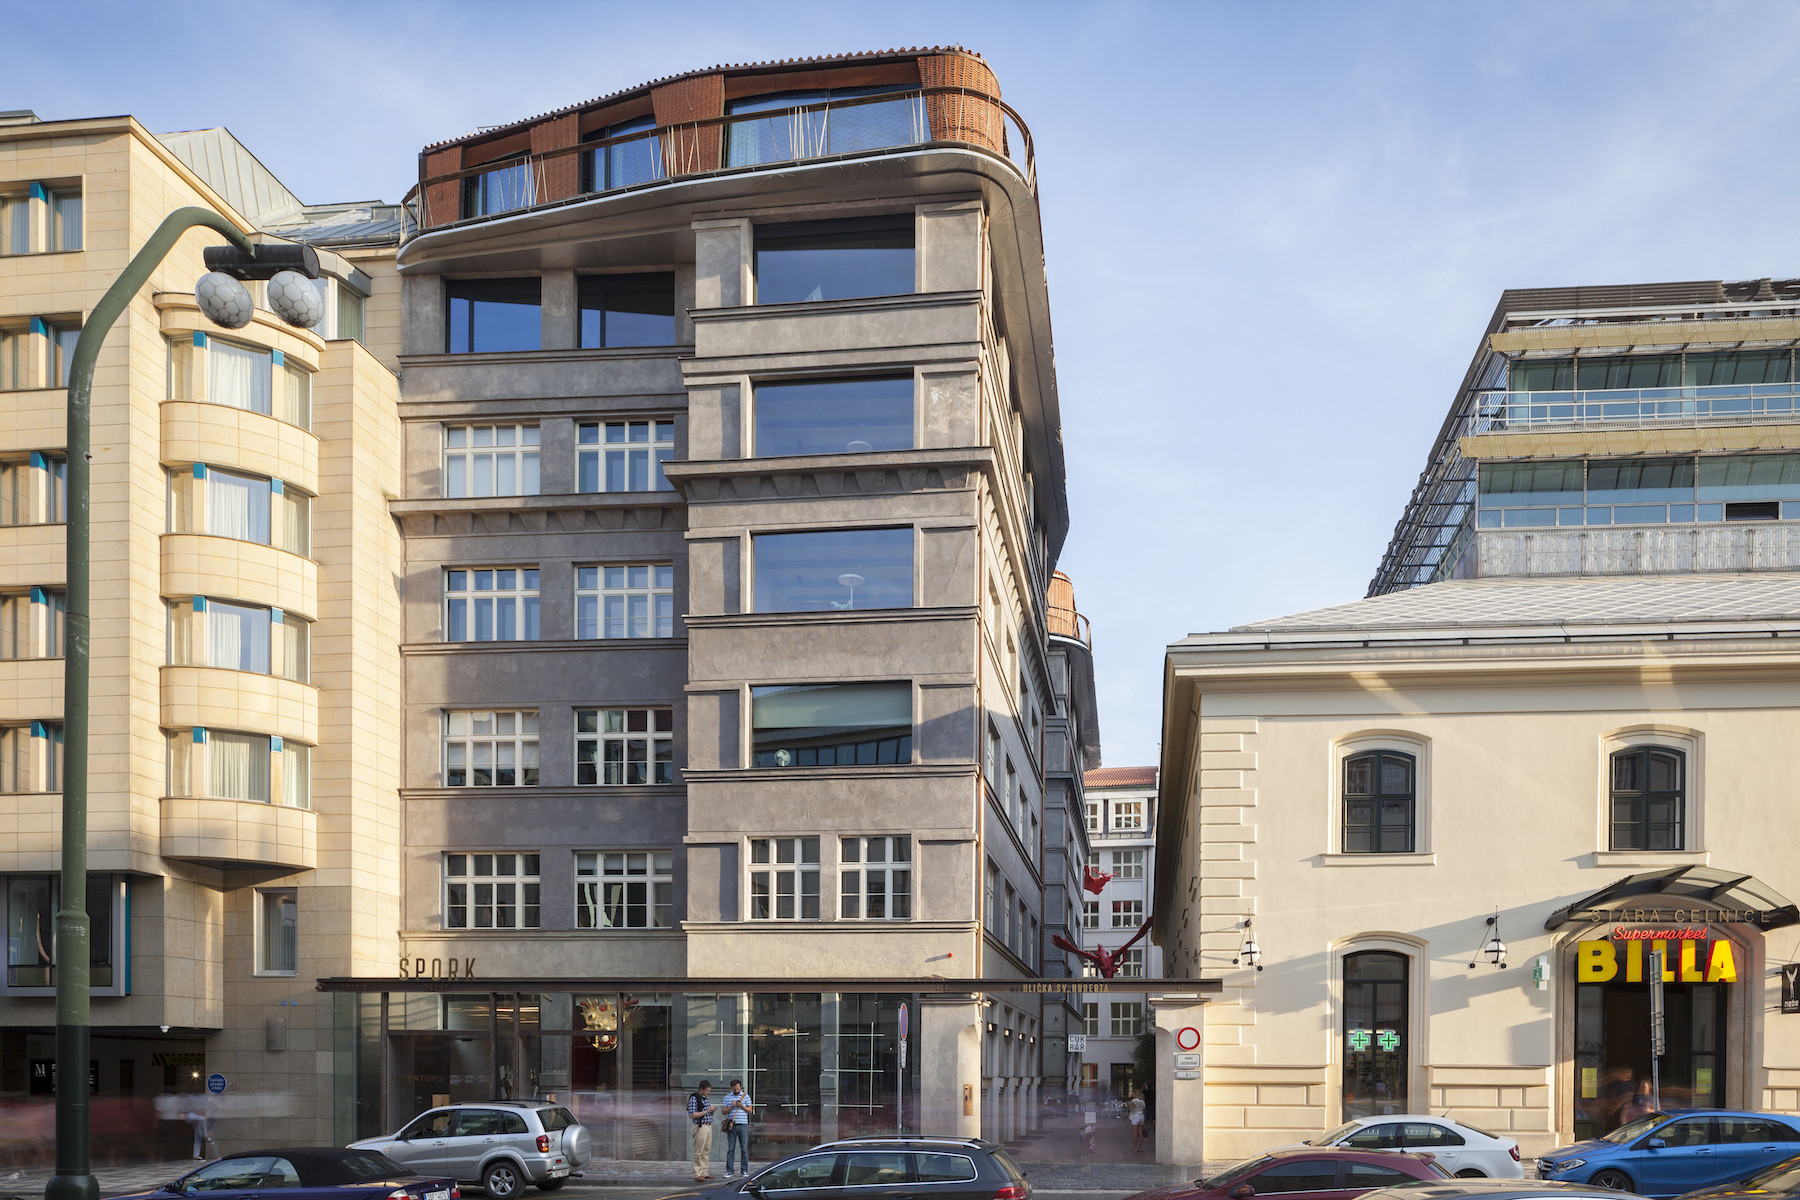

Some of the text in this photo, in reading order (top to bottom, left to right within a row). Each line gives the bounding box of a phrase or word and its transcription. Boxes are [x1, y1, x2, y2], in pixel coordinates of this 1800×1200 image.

[1674, 909, 1771, 923] CELNICE
[1613, 926, 1708, 941] Supermarket
[1577, 939, 1738, 983] BILLA
[1072, 983, 1109, 993] HUBERTA
[1069, 1035, 1085, 1043] CUK
